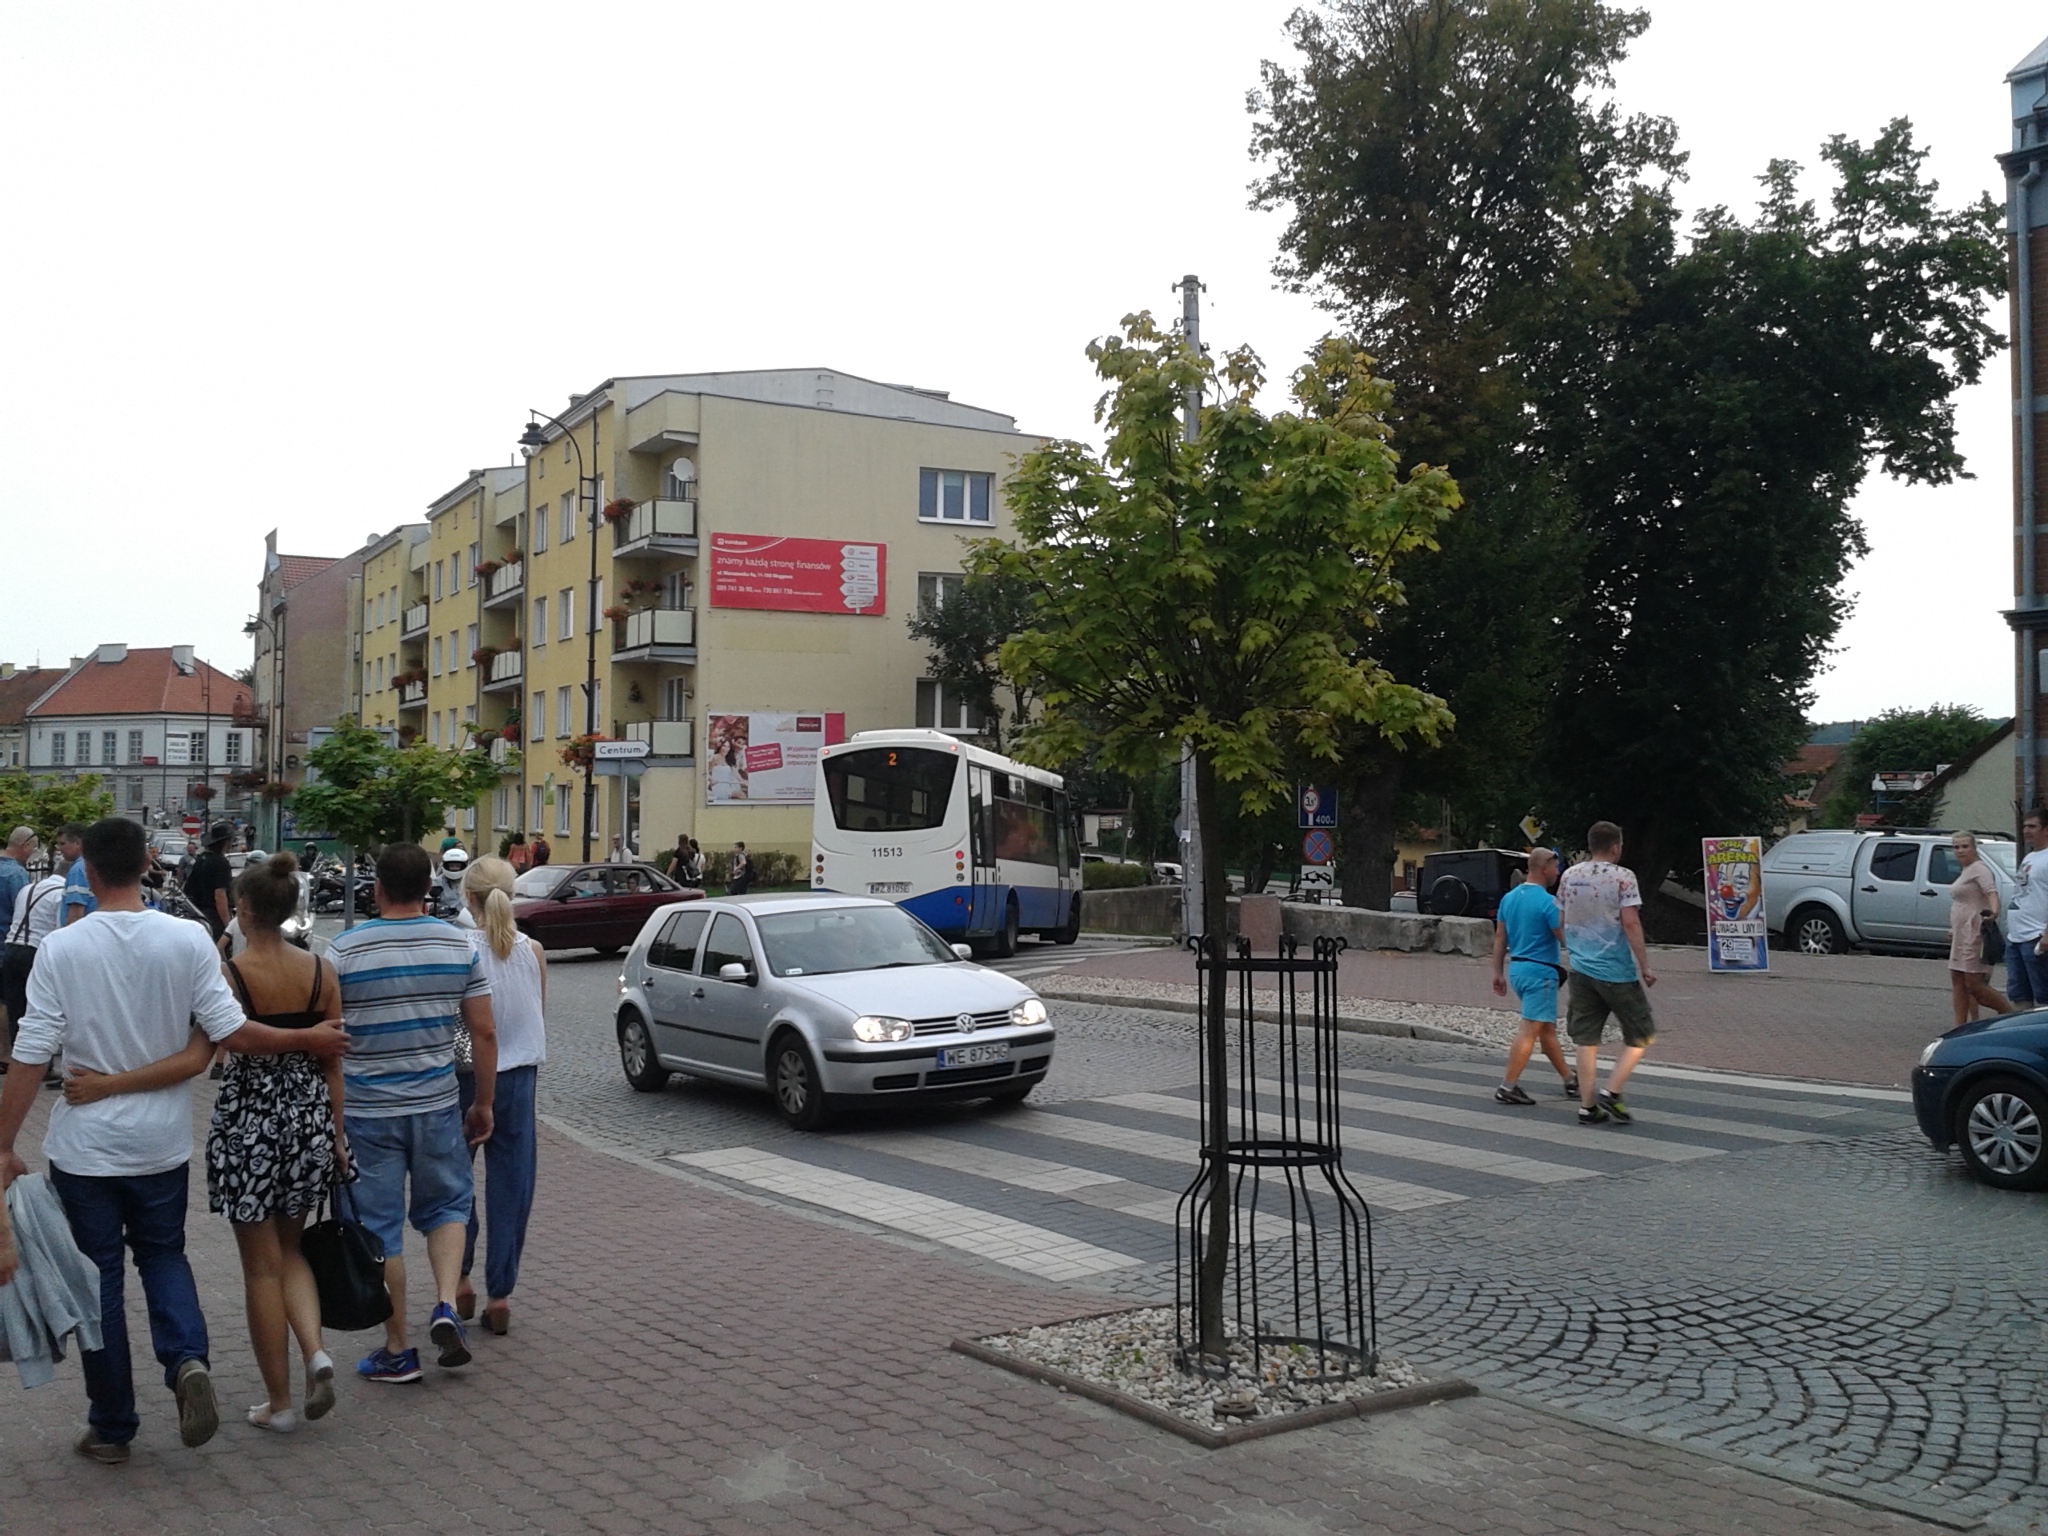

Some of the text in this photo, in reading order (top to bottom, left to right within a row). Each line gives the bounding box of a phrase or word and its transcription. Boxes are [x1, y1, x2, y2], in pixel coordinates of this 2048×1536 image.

[716, 557, 832, 571] znamy każdą stronę finansów
[599, 745, 642, 755] Centrum
[888, 752, 897, 766] 2
[871, 847, 903, 858] 11513
[1707, 850, 1758, 863] ARENA
[1716, 923, 1738, 934] UWAGA
[1742, 923, 1755, 934] LWY
[1722, 939, 1734, 950] 29
[946, 1044, 1008, 1065] WE 875HG
